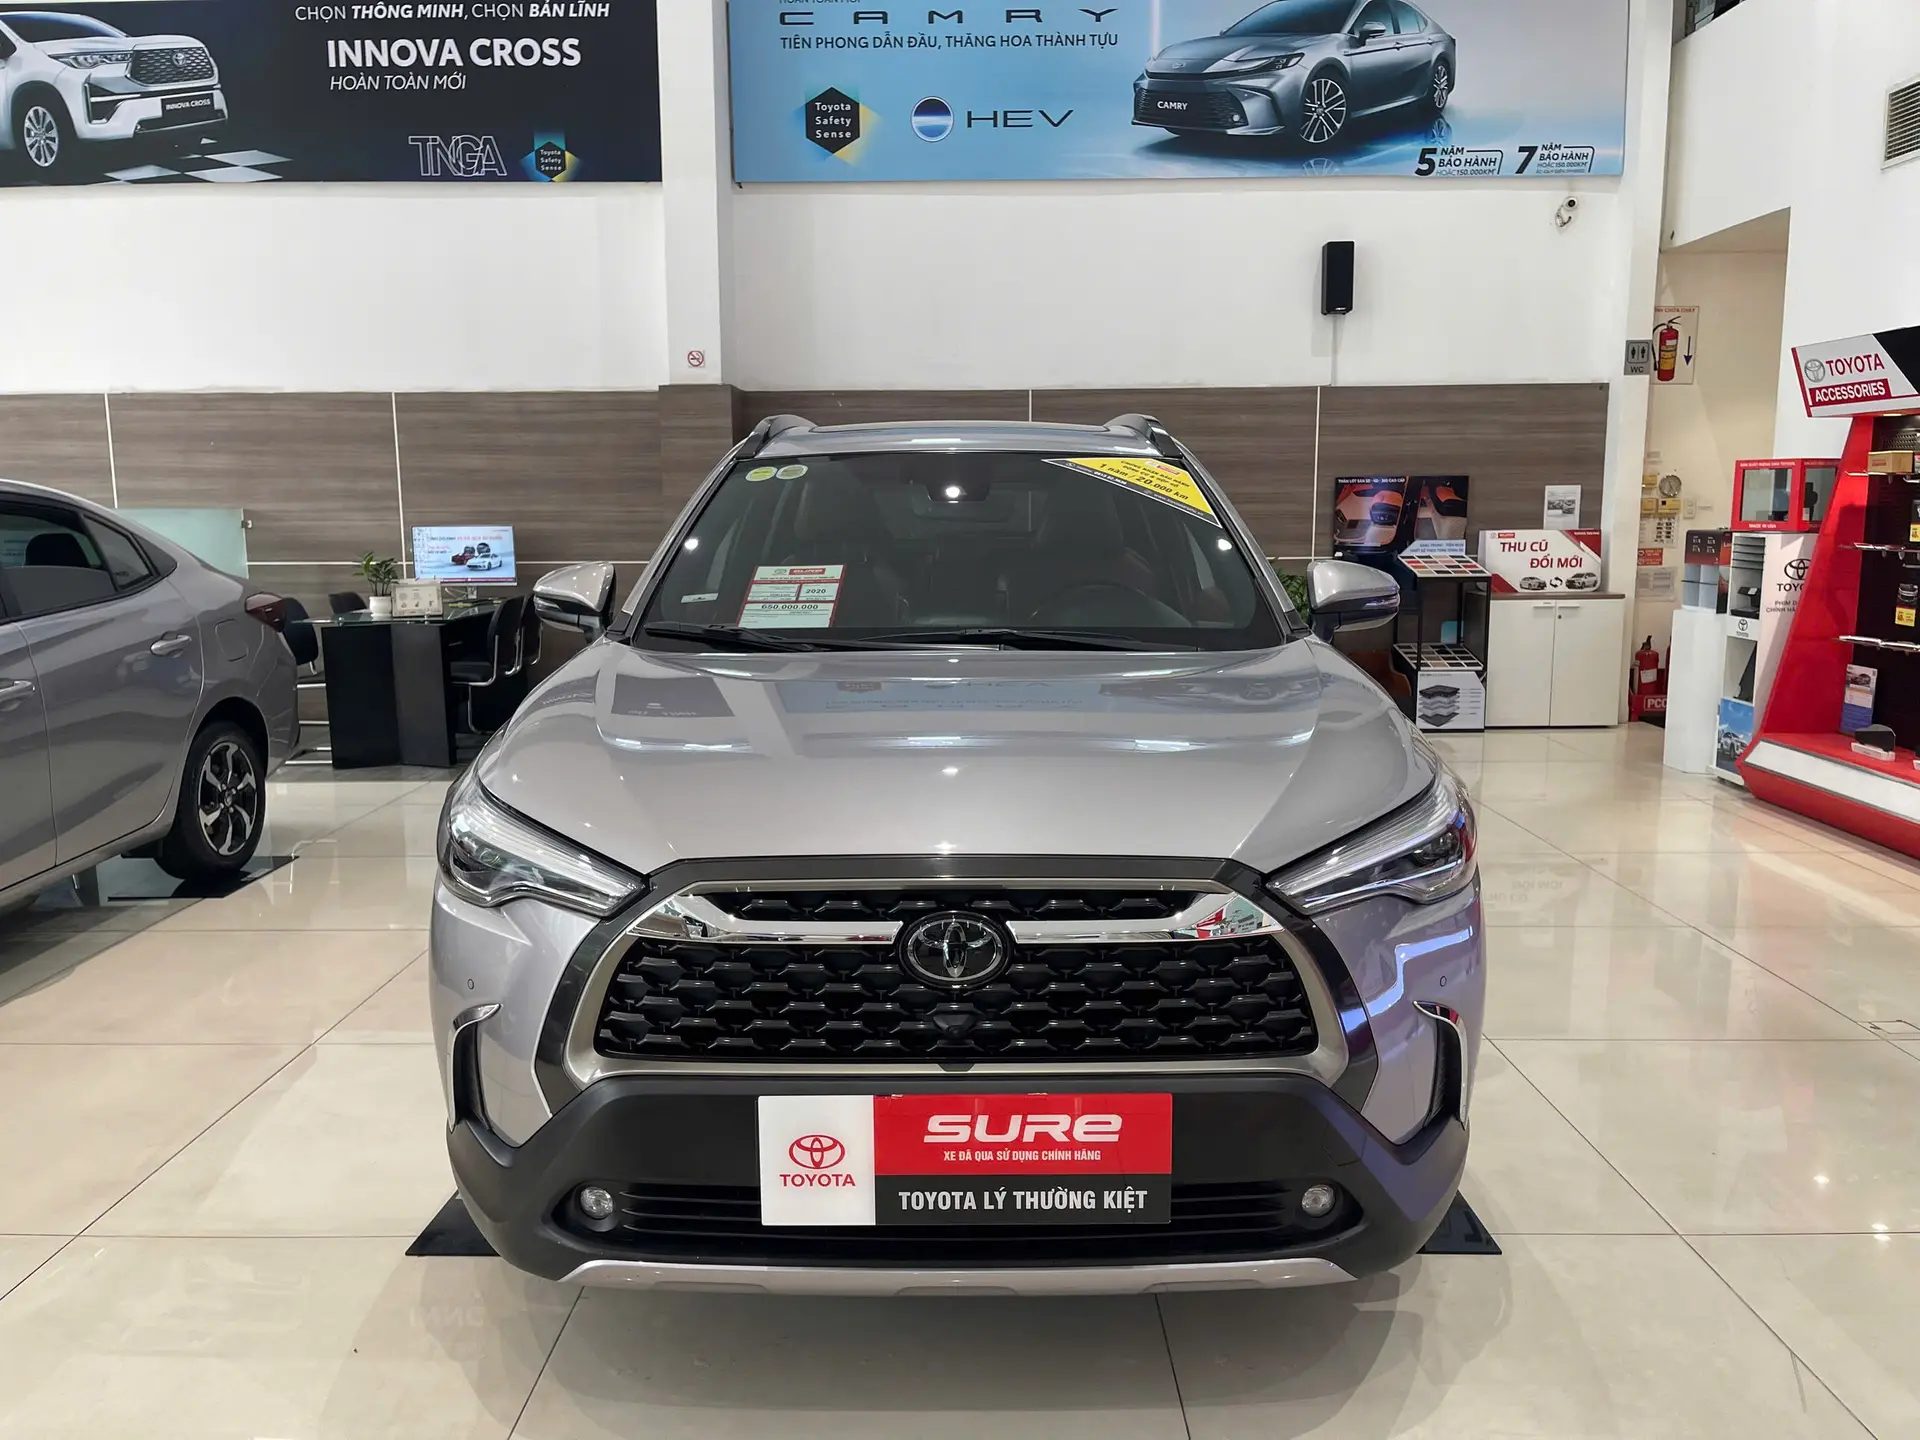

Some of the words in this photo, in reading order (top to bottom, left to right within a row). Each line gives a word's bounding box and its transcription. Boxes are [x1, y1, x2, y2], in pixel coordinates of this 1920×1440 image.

[295, 6, 346, 22] CHỌN
[351, 2, 413, 19] THÔNG
[416, 4, 468, 20] MINH,
[472, 4, 523, 21] CHỌN
[529, 1, 564, 17] BẢN
[569, 1, 609, 17] LĨNH
[780, 9, 1118, 25] CAMRY
[781, 33, 811, 49] TIÊN
[816, 36, 869, 49] PHONG
[873, 31, 904, 48] DẪN
[907, 32, 941, 50] ĐẦU,
[945, 33, 996, 48] THĂNG
[1000, 35, 1032, 47] HOA
[1036, 31, 1086, 46] THÀNH
[1089, 33, 1118, 50] TỰU
[327, 39, 463, 67] INNOVA
[470, 38, 581, 67] CROSS
[330, 73, 379, 90] HOÀN
[384, 72, 428, 90] TOÀN
[434, 73, 466, 89] MỚI
[190, 99, 211, 108] CROSS
[815, 102, 852, 114] Toyota
[1157, 101, 1188, 110] CAMRY
[815, 116, 852, 128] Safety
[966, 110, 1073, 128] HEV
[816, 130, 852, 139] Sense
[1415, 148, 1437, 176] 5
[1440, 145, 1464, 155] NĂM
[1439, 156, 1462, 167] BẢO
[1464, 155, 1497, 167] HÀNH
[1515, 146, 1538, 174] 7
[1541, 142, 1561, 151] NĂM
[1539, 151, 1559, 161] BẢO
[1560, 150, 1589, 161] HÀNH
[1825, 353, 1885, 376] TOYOTA
[1815, 382, 1886, 402] ACCESSORIES
[1107, 467, 1129, 477] năm
[1136, 476, 1173, 493] 20.000
[1173, 491, 1189, 500] km
[1500, 542, 1527, 552] THU
[1530, 539, 1548, 552] CŨ
[1530, 554, 1553, 568] ĐỔI
[1557, 555, 1582, 568] MỚI
[943, 1151, 957, 1161] XE
[959, 1148, 972, 1161] ĐÃ
[974, 1150, 994, 1161] QUA
[996, 1148, 1010, 1161] SỬ
[1012, 1150, 1039, 1163] DỤNG
[1042, 1147, 1071, 1161] CHÍNH
[1074, 1148, 1101, 1161] HÃNG
[779, 1174, 856, 1187] TOYOTA
[899, 1191, 977, 1210] TOYOTA
[983, 1186, 1006, 1210] LÝ
[1013, 1186, 1095, 1210] THƯỜNG
[1103, 1185, 1147, 1213] KIỆT
